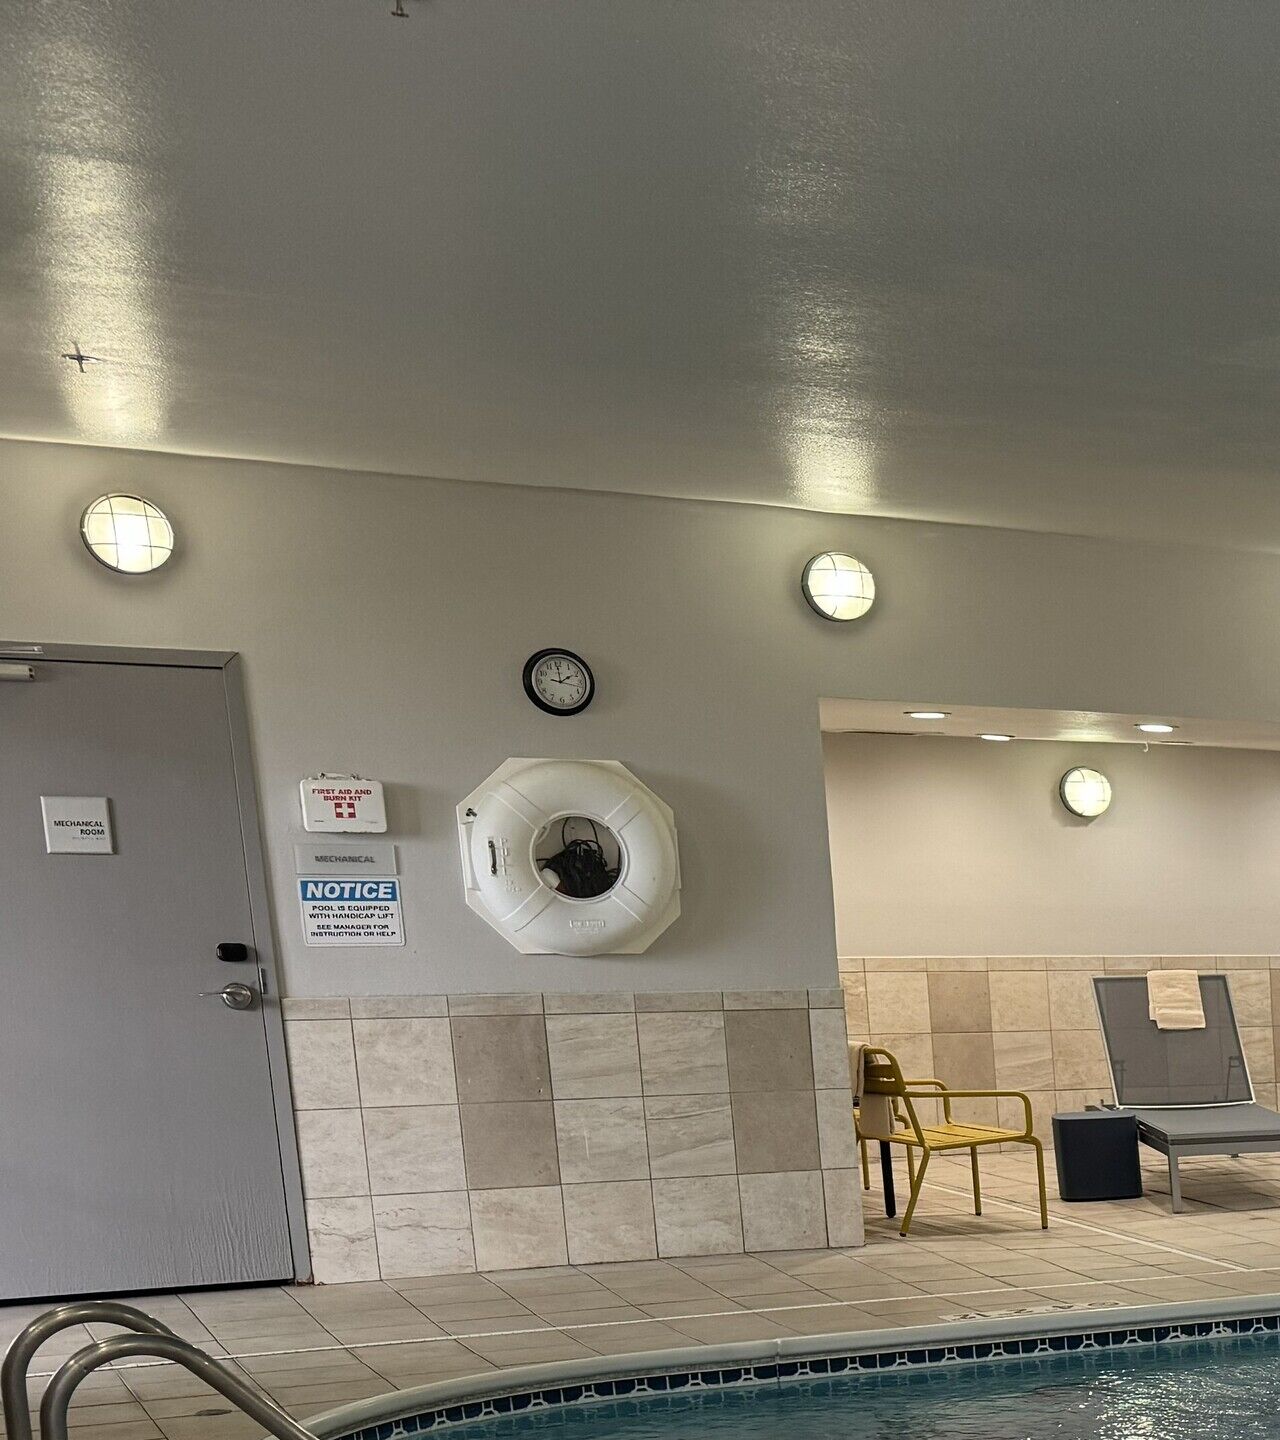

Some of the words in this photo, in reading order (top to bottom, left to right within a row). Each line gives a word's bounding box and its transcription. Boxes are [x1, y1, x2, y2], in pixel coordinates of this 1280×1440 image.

[53, 820, 104, 828] MECHANICAL
[80, 828, 105, 836] ROOM
[314, 855, 375, 864] MECHANICAL
[306, 882, 393, 899] NOTICE
